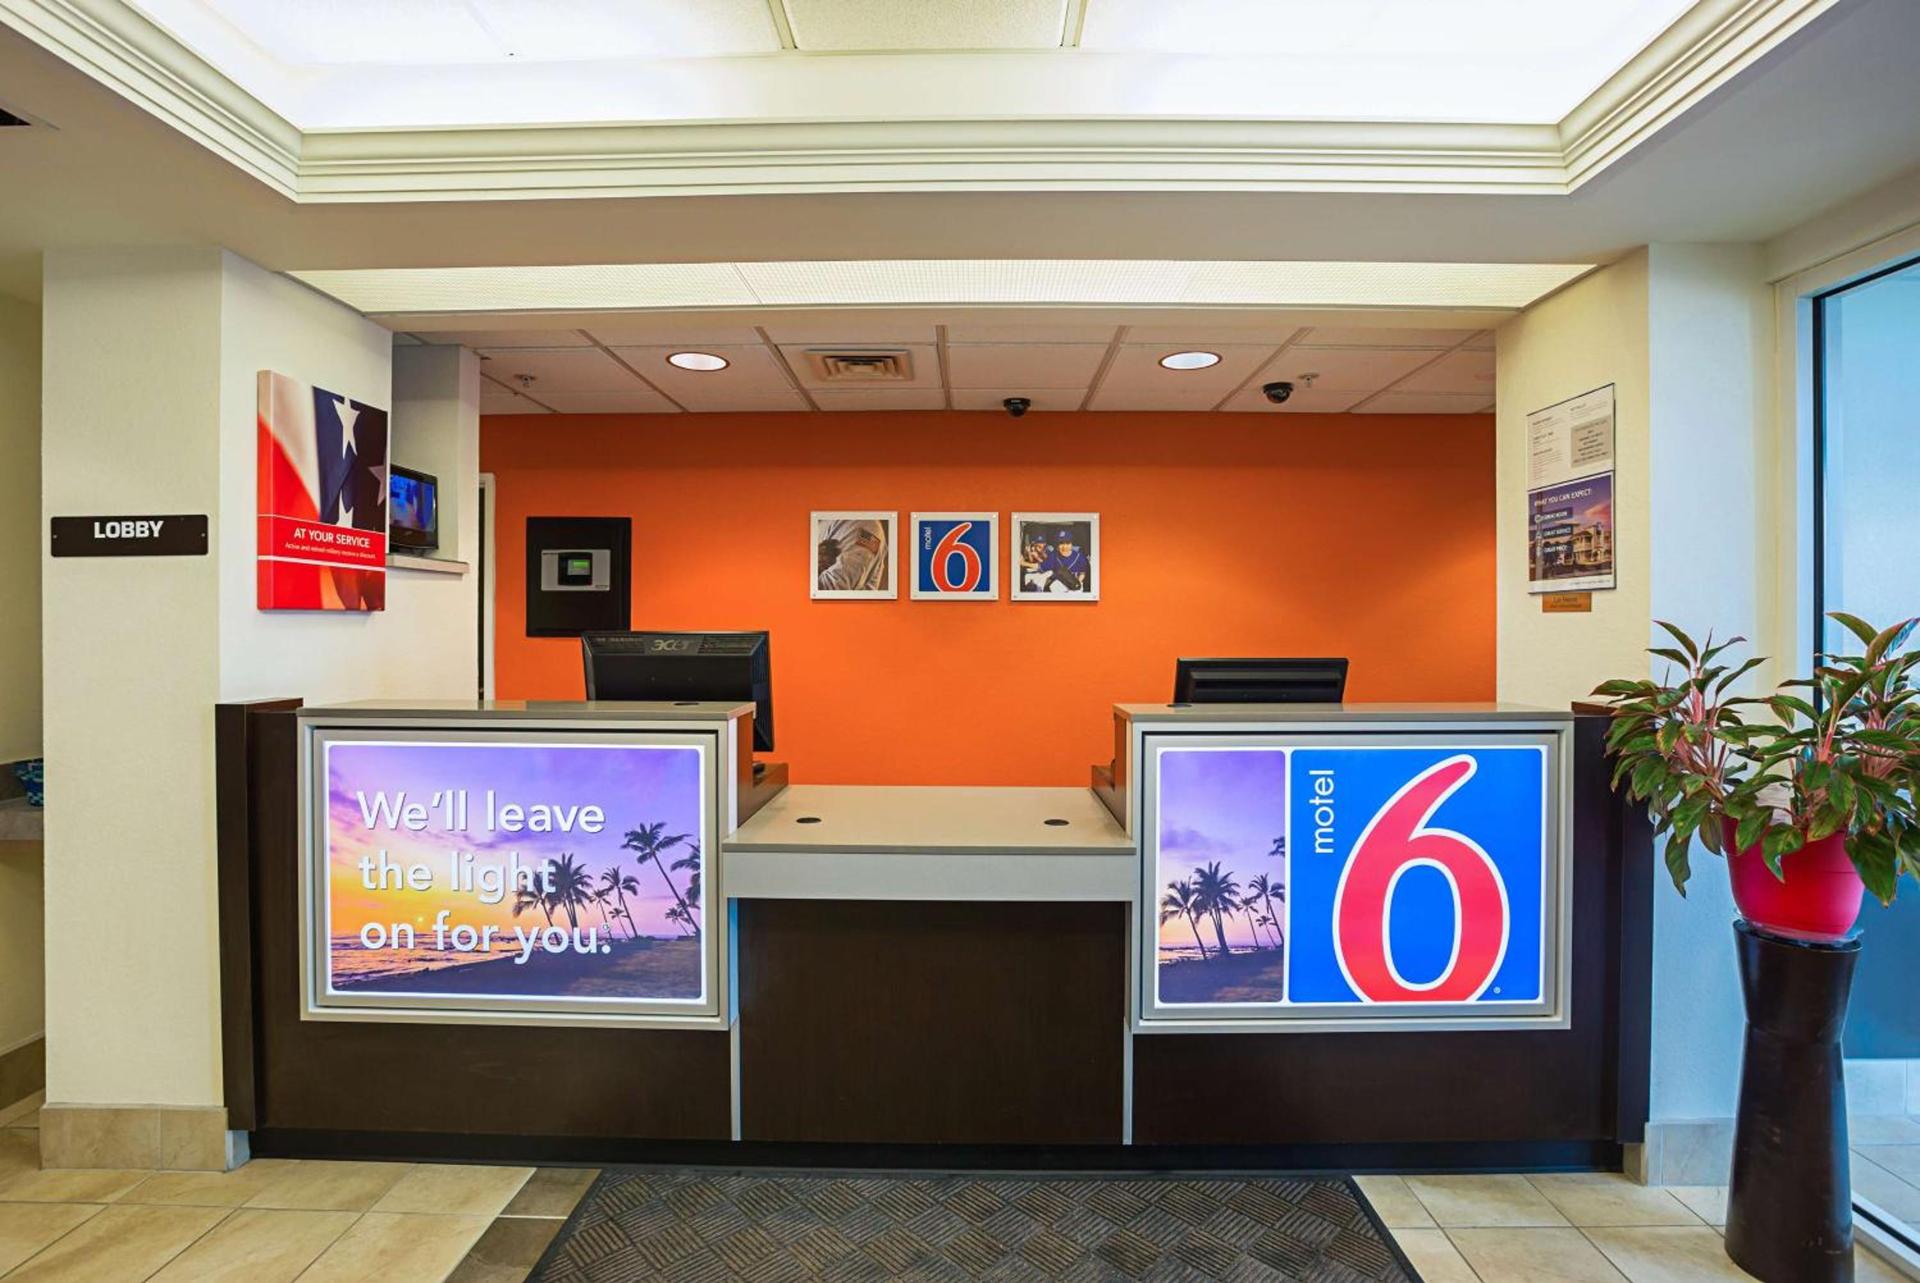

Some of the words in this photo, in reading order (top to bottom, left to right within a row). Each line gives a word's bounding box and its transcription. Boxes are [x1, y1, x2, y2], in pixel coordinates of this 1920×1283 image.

[94, 520, 164, 538] LOBBY
[293, 527, 307, 539] AT
[309, 529, 334, 543] YOUR
[336, 534, 371, 548] SERVICE
[924, 526, 932, 550] motel
[930, 521, 982, 592] 6
[651, 639, 692, 651] acer
[356, 789, 469, 832] We'll
[486, 789, 607, 834] leave
[1308, 769, 1335, 855] motel
[358, 850, 433, 891] the
[450, 851, 557, 905] light
[1333, 754, 1510, 1003] 6
[360, 921, 415, 950] on
[432, 910, 501, 953] for
[509, 922, 612, 966] you.
